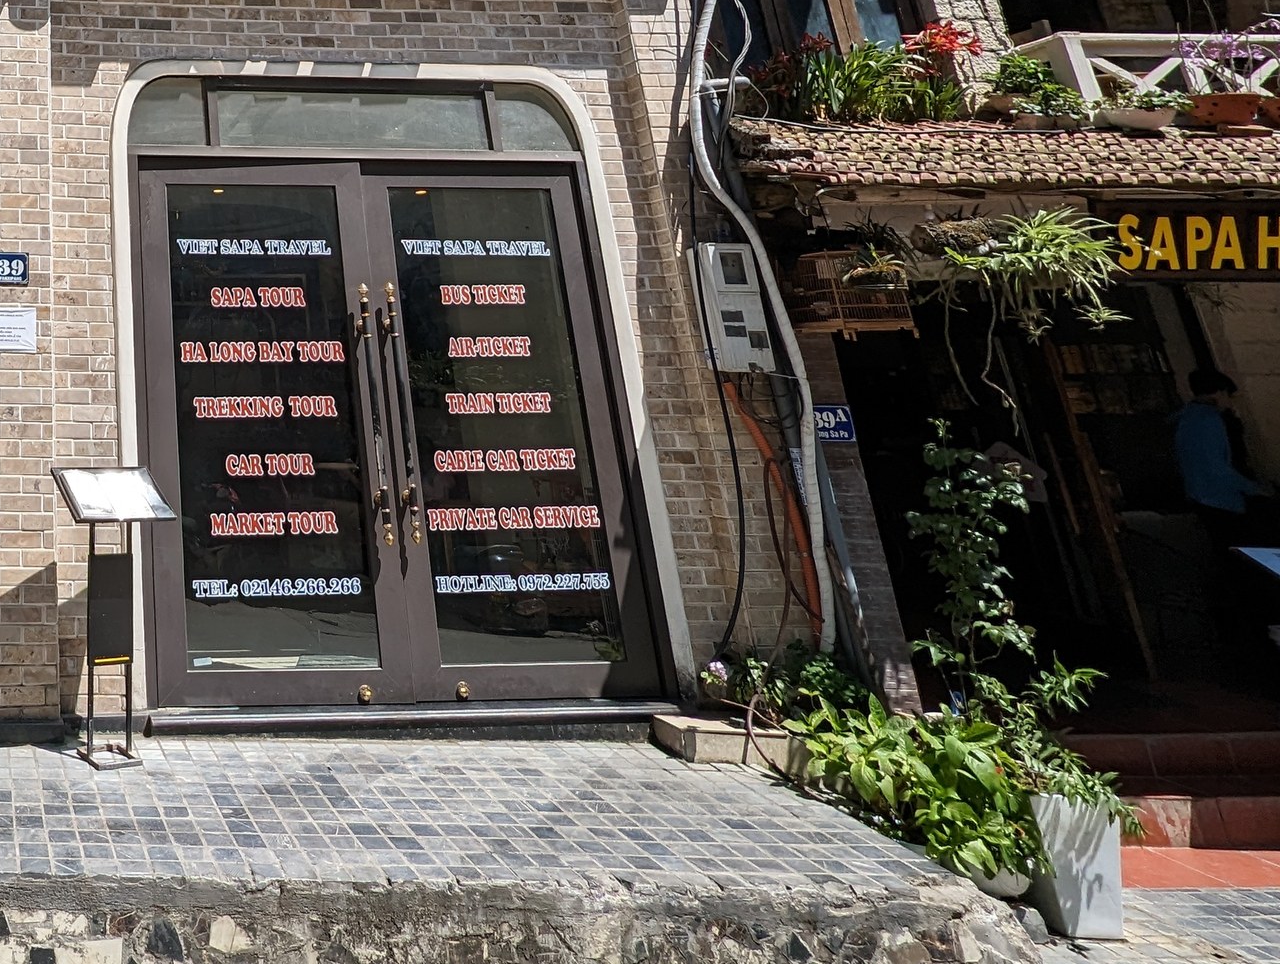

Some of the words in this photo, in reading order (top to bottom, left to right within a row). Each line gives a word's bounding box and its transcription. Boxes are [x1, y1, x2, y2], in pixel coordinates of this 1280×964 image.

[177, 239, 218, 254] VIET
[220, 239, 264, 254] SAPA
[265, 240, 331, 255] TRAVEL
[401, 239, 442, 255] VIET
[443, 240, 486, 256] SAPA
[486, 241, 551, 257] TRAVEL
[1118, 213, 1245, 270] SAPA
[210, 287, 257, 307] SAPA
[258, 287, 306, 307] TOUR
[440, 285, 471, 304] BUS
[471, 285, 526, 304] TICKET
[180, 341, 208, 362] HA
[209, 341, 256, 362] LONG
[259, 341, 295, 362] BAY
[297, 341, 345, 362] TOUR
[193, 397, 284, 418] TREKKING
[288, 396, 338, 417] TOUR
[445, 392, 495, 413] TRAIN
[496, 392, 552, 413] TICKET
[225, 453, 264, 476] CAR
[265, 453, 315, 476] TOUR
[434, 450, 485, 472] CABLE
[486, 449, 520, 471] CAR
[520, 448, 576, 470] TICKET
[211, 512, 285, 536] MARKET
[288, 511, 339, 535] TOUR
[427, 508, 497, 531] PRIVATE
[498, 506, 533, 529] CAR
[533, 506, 601, 529] SERVICE
[193, 579, 238, 597] TEL:
[240, 577, 361, 597] 02146.266.266
[435, 575, 517, 593] HOTLINE:
[518, 572, 611, 591] 0972.227.755
